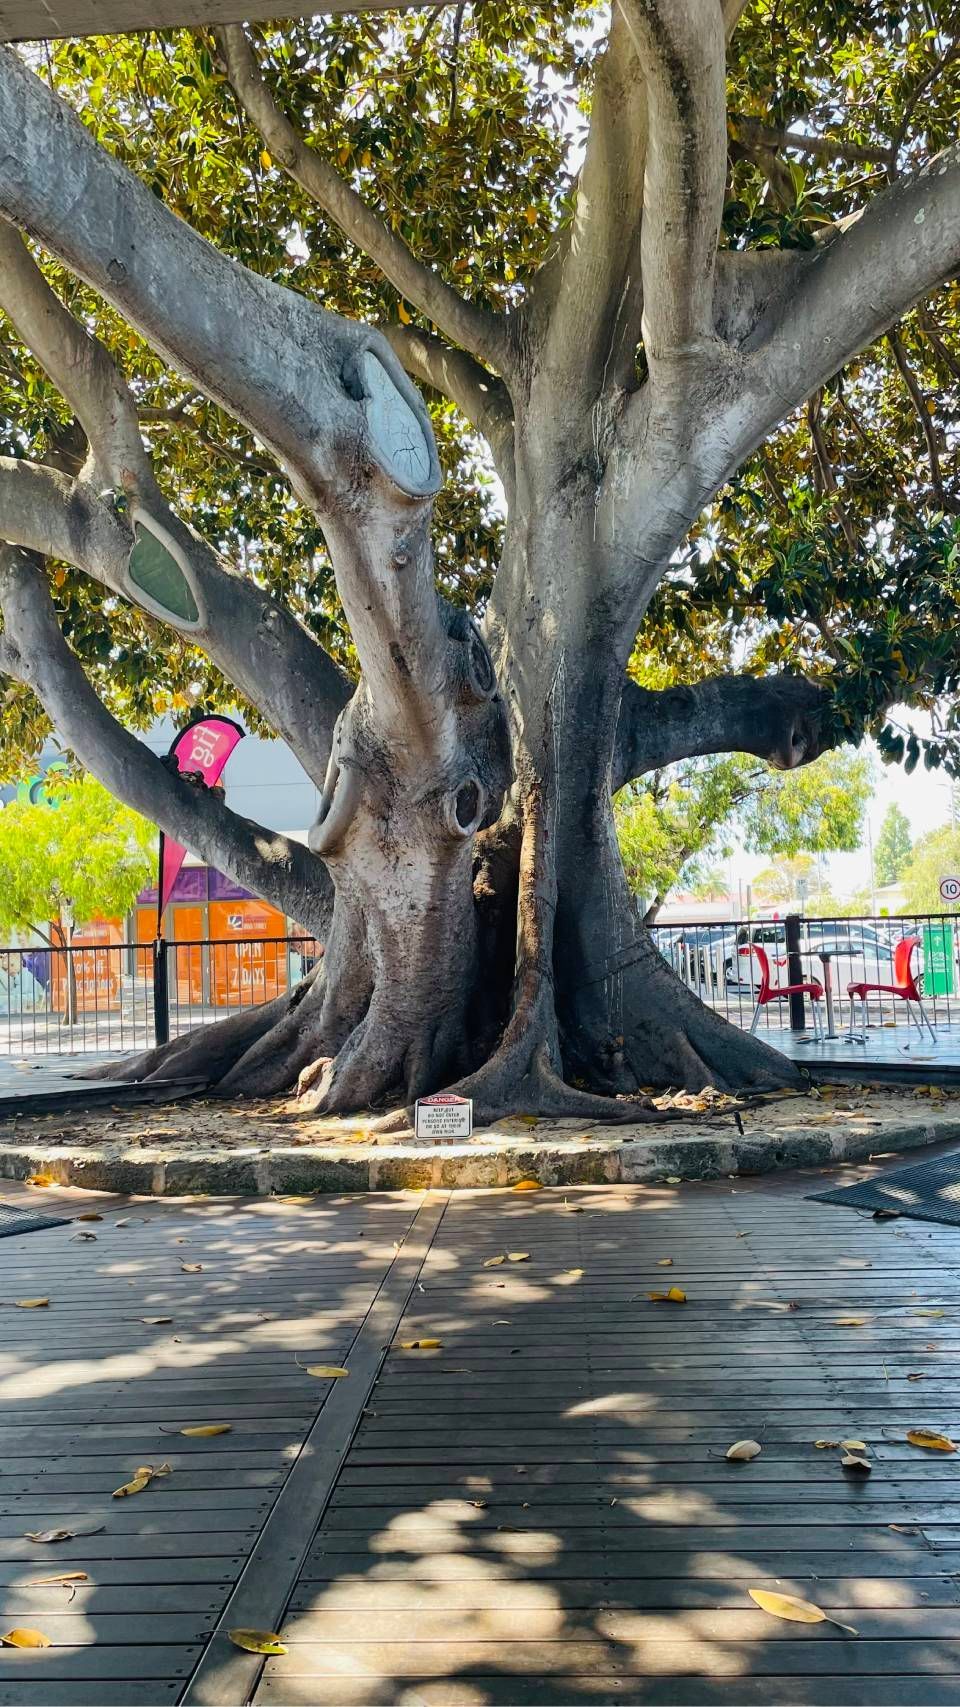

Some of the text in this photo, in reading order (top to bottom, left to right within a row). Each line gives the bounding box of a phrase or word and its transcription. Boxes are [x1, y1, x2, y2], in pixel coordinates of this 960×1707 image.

[945, 884, 957, 894] 10
[235, 942, 261, 958] OPEN
[231, 968, 264, 985] 7 DAYS
